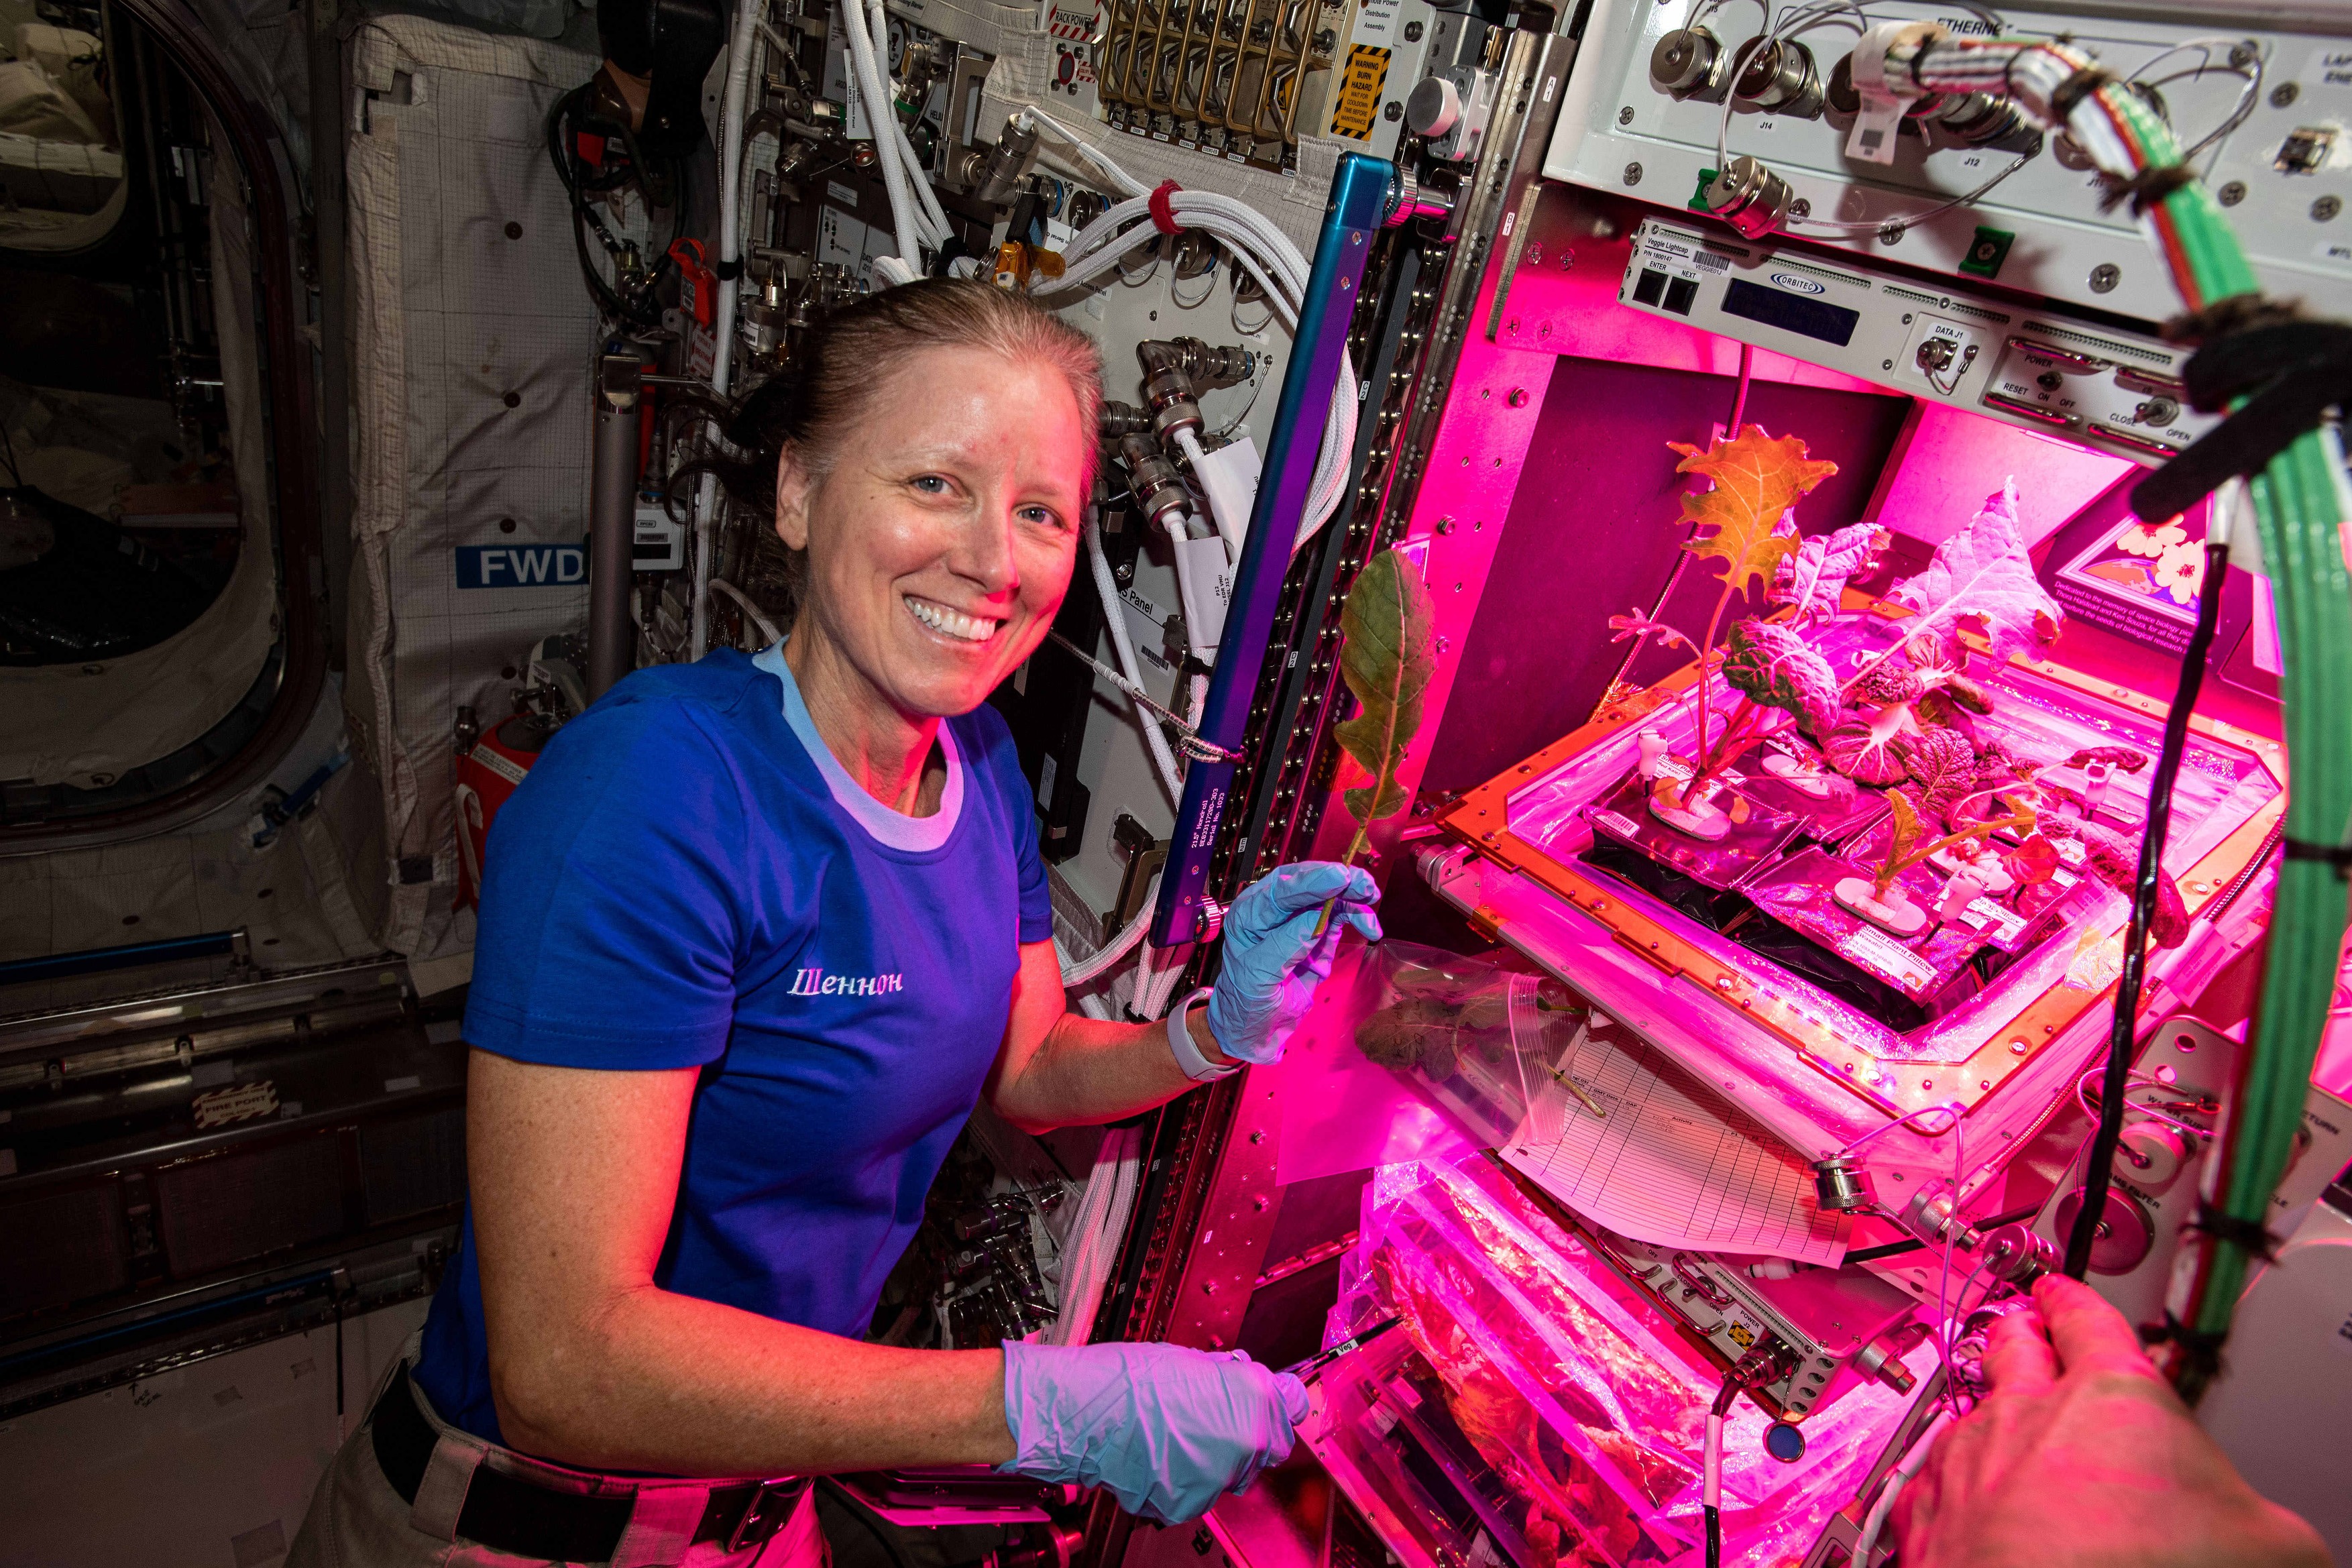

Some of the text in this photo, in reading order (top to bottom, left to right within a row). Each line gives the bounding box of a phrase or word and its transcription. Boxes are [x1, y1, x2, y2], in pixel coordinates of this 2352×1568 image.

[1056, 12, 1070, 24] RACK
[1365, 9, 1390, 19] Distribution
[1363, 22, 1386, 32] Assembly
[1355, 60, 1379, 70] WARNING
[1357, 71, 1372, 80] BURN
[1351, 81, 1372, 92] HAZARD
[1347, 99, 1369, 109] COOLDOWN
[1341, 115, 1367, 125] MAINTENANCE
[1353, 109, 1368, 117] BEFORE
[1964, 156, 1981, 168] J12
[1050, 233, 1064, 243] Serial
[1647, 237, 1689, 255] Veggie Lightcap
[1653, 252, 1673, 262] 1800147
[1649, 261, 1697, 280] ENTER NEXT
[1080, 281, 1095, 291] Access
[1095, 286, 1107, 296] Panel
[1781, 277, 1814, 291] ORBITEC
[1935, 326, 1954, 337] DATA
[2024, 354, 2053, 368] POWER
[2003, 382, 2076, 408] RESET ON OFF
[2166, 429, 2192, 441] OPEN
[480, 549, 585, 585] FWD
[1129, 590, 1154, 615] Panel
[2054, 581, 2085, 598] Dedicated
[2092, 594, 2102, 603] the
[2103, 600, 2129, 614] memory
[2136, 612, 2155, 624] space
[2155, 618, 2180, 633] biology
[2056, 590, 2074, 601] Thora
[2073, 595, 2099, 611] Halstead
[2099, 606, 2112, 616] and
[2112, 611, 2125, 620] Ken
[2147, 624, 2157, 632] for
[2157, 628, 2166, 636] all
[2166, 632, 2180, 643] they
[2063, 602, 2084, 615] nurture
[2084, 610, 2095, 618] the
[2096, 614, 2115, 626] seeds
[2123, 626, 2153, 642] biological
[2153, 636, 2182, 653] research
[1196, 800, 1208, 830] Handrail
[1207, 793, 1225, 846] Serial No. 1033
[1857, 932, 1883, 950] (Wasabi)
[1863, 925, 1886, 941] Small
[1886, 939, 1907, 956] Plant
[1907, 952, 1932, 972] Pillow
[787, 968, 903, 997] Шеннон
[205, 1102, 233, 1115] FIRE
[234, 1095, 267, 1108] PORT
[1593, 1088, 1606, 1097] GMT
[1606, 1093, 1619, 1101] Date
[1672, 1117, 1693, 1125] Activity
[2129, 1185, 2162, 1209] FILTER
[1648, 1249, 1659, 1259] OFF
[1677, 1274, 1724, 1317] CLOSE OPEN
[1740, 1310, 1760, 1329] POWER
[1339, 1343, 1353, 1353] Veg
